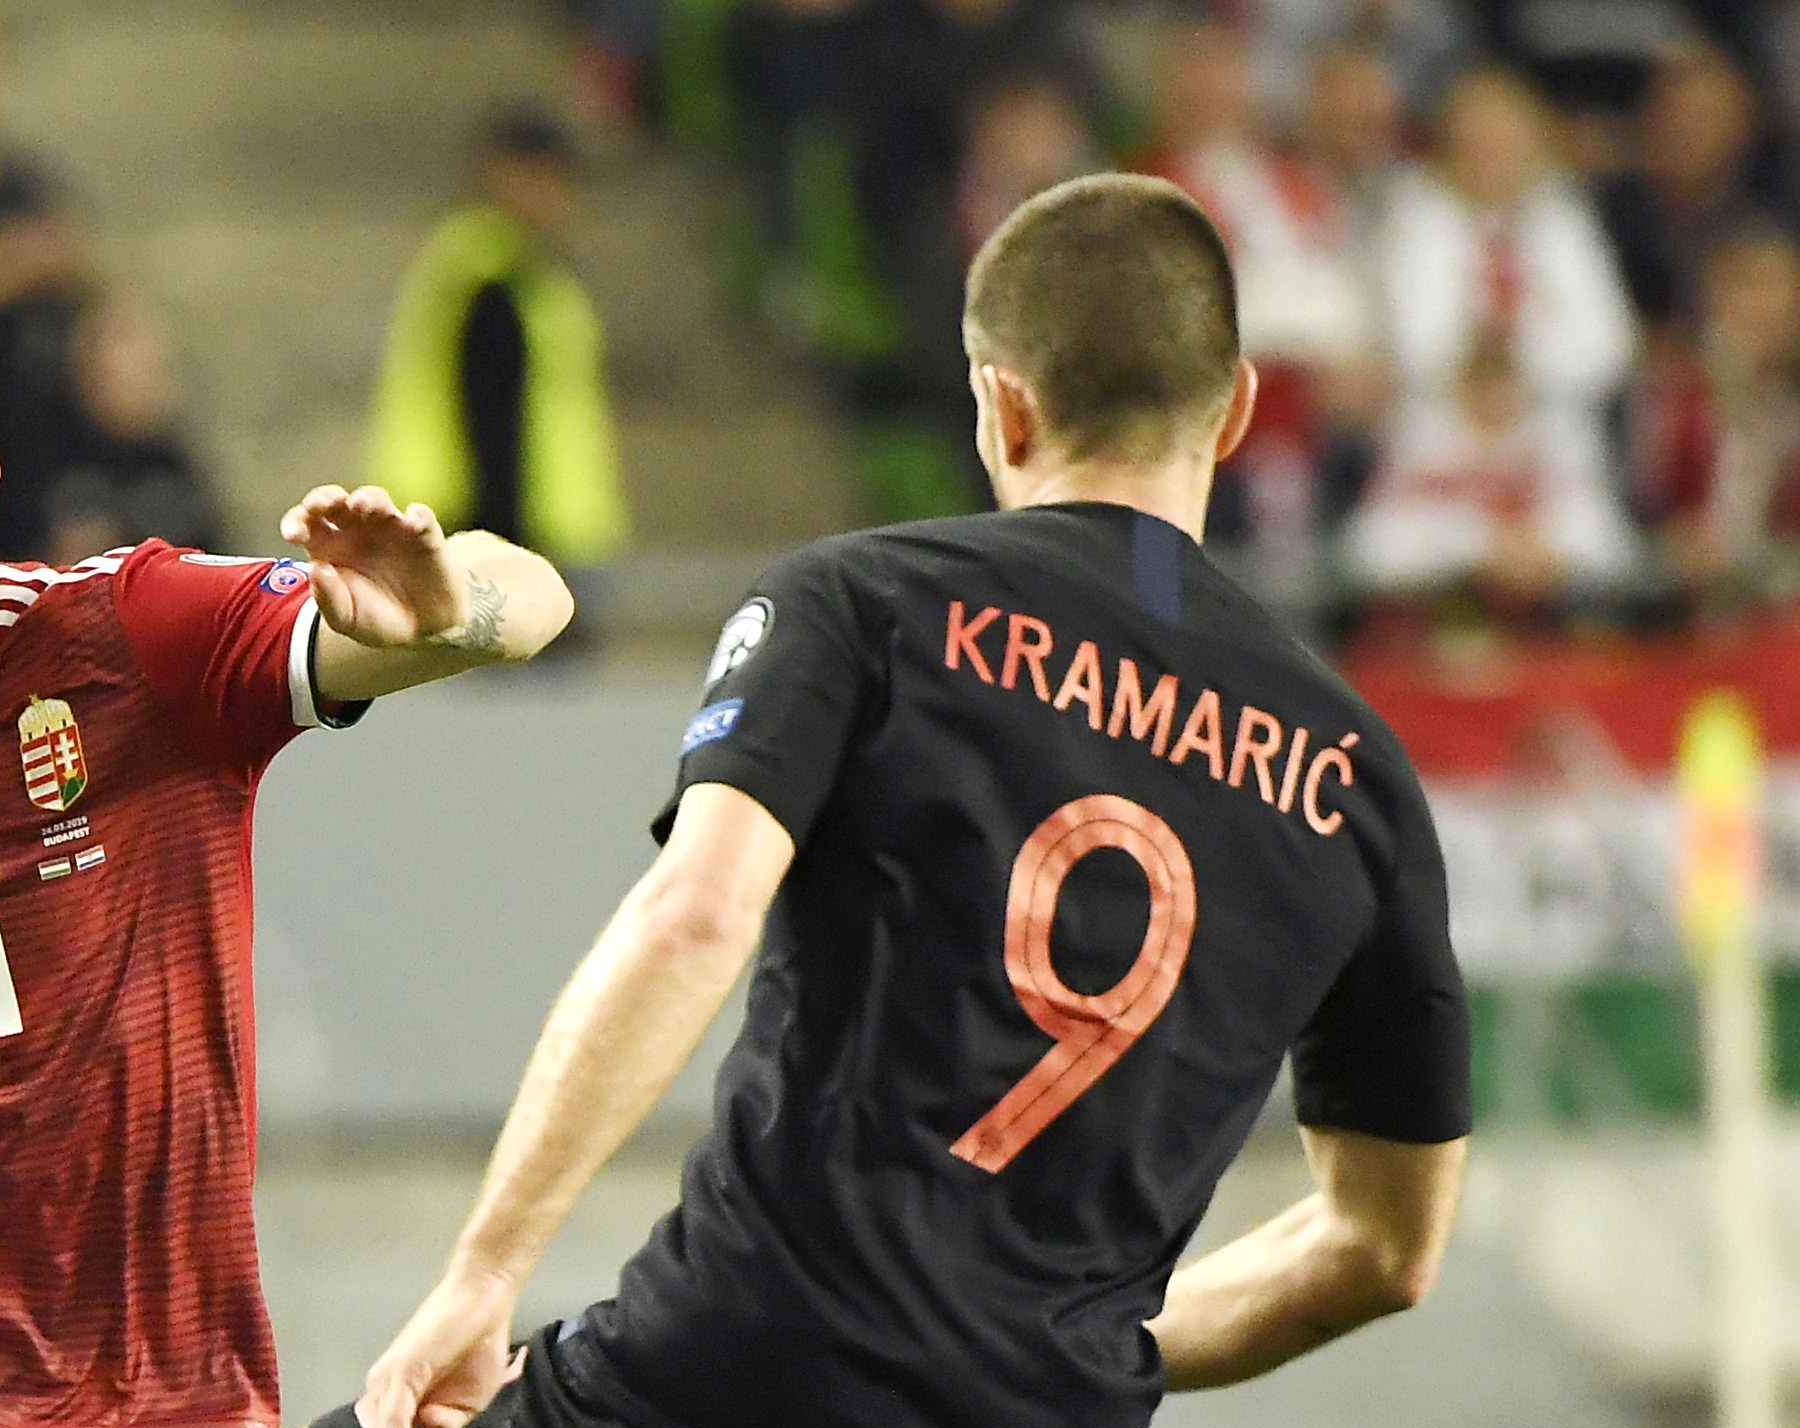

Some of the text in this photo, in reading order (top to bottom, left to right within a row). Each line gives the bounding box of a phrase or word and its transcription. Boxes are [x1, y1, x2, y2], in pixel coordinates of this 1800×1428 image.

[944, 600, 1360, 835] KRAMARIĆ
[43, 826, 90, 847] BUDAPEST
[949, 794, 1196, 1174] 9
